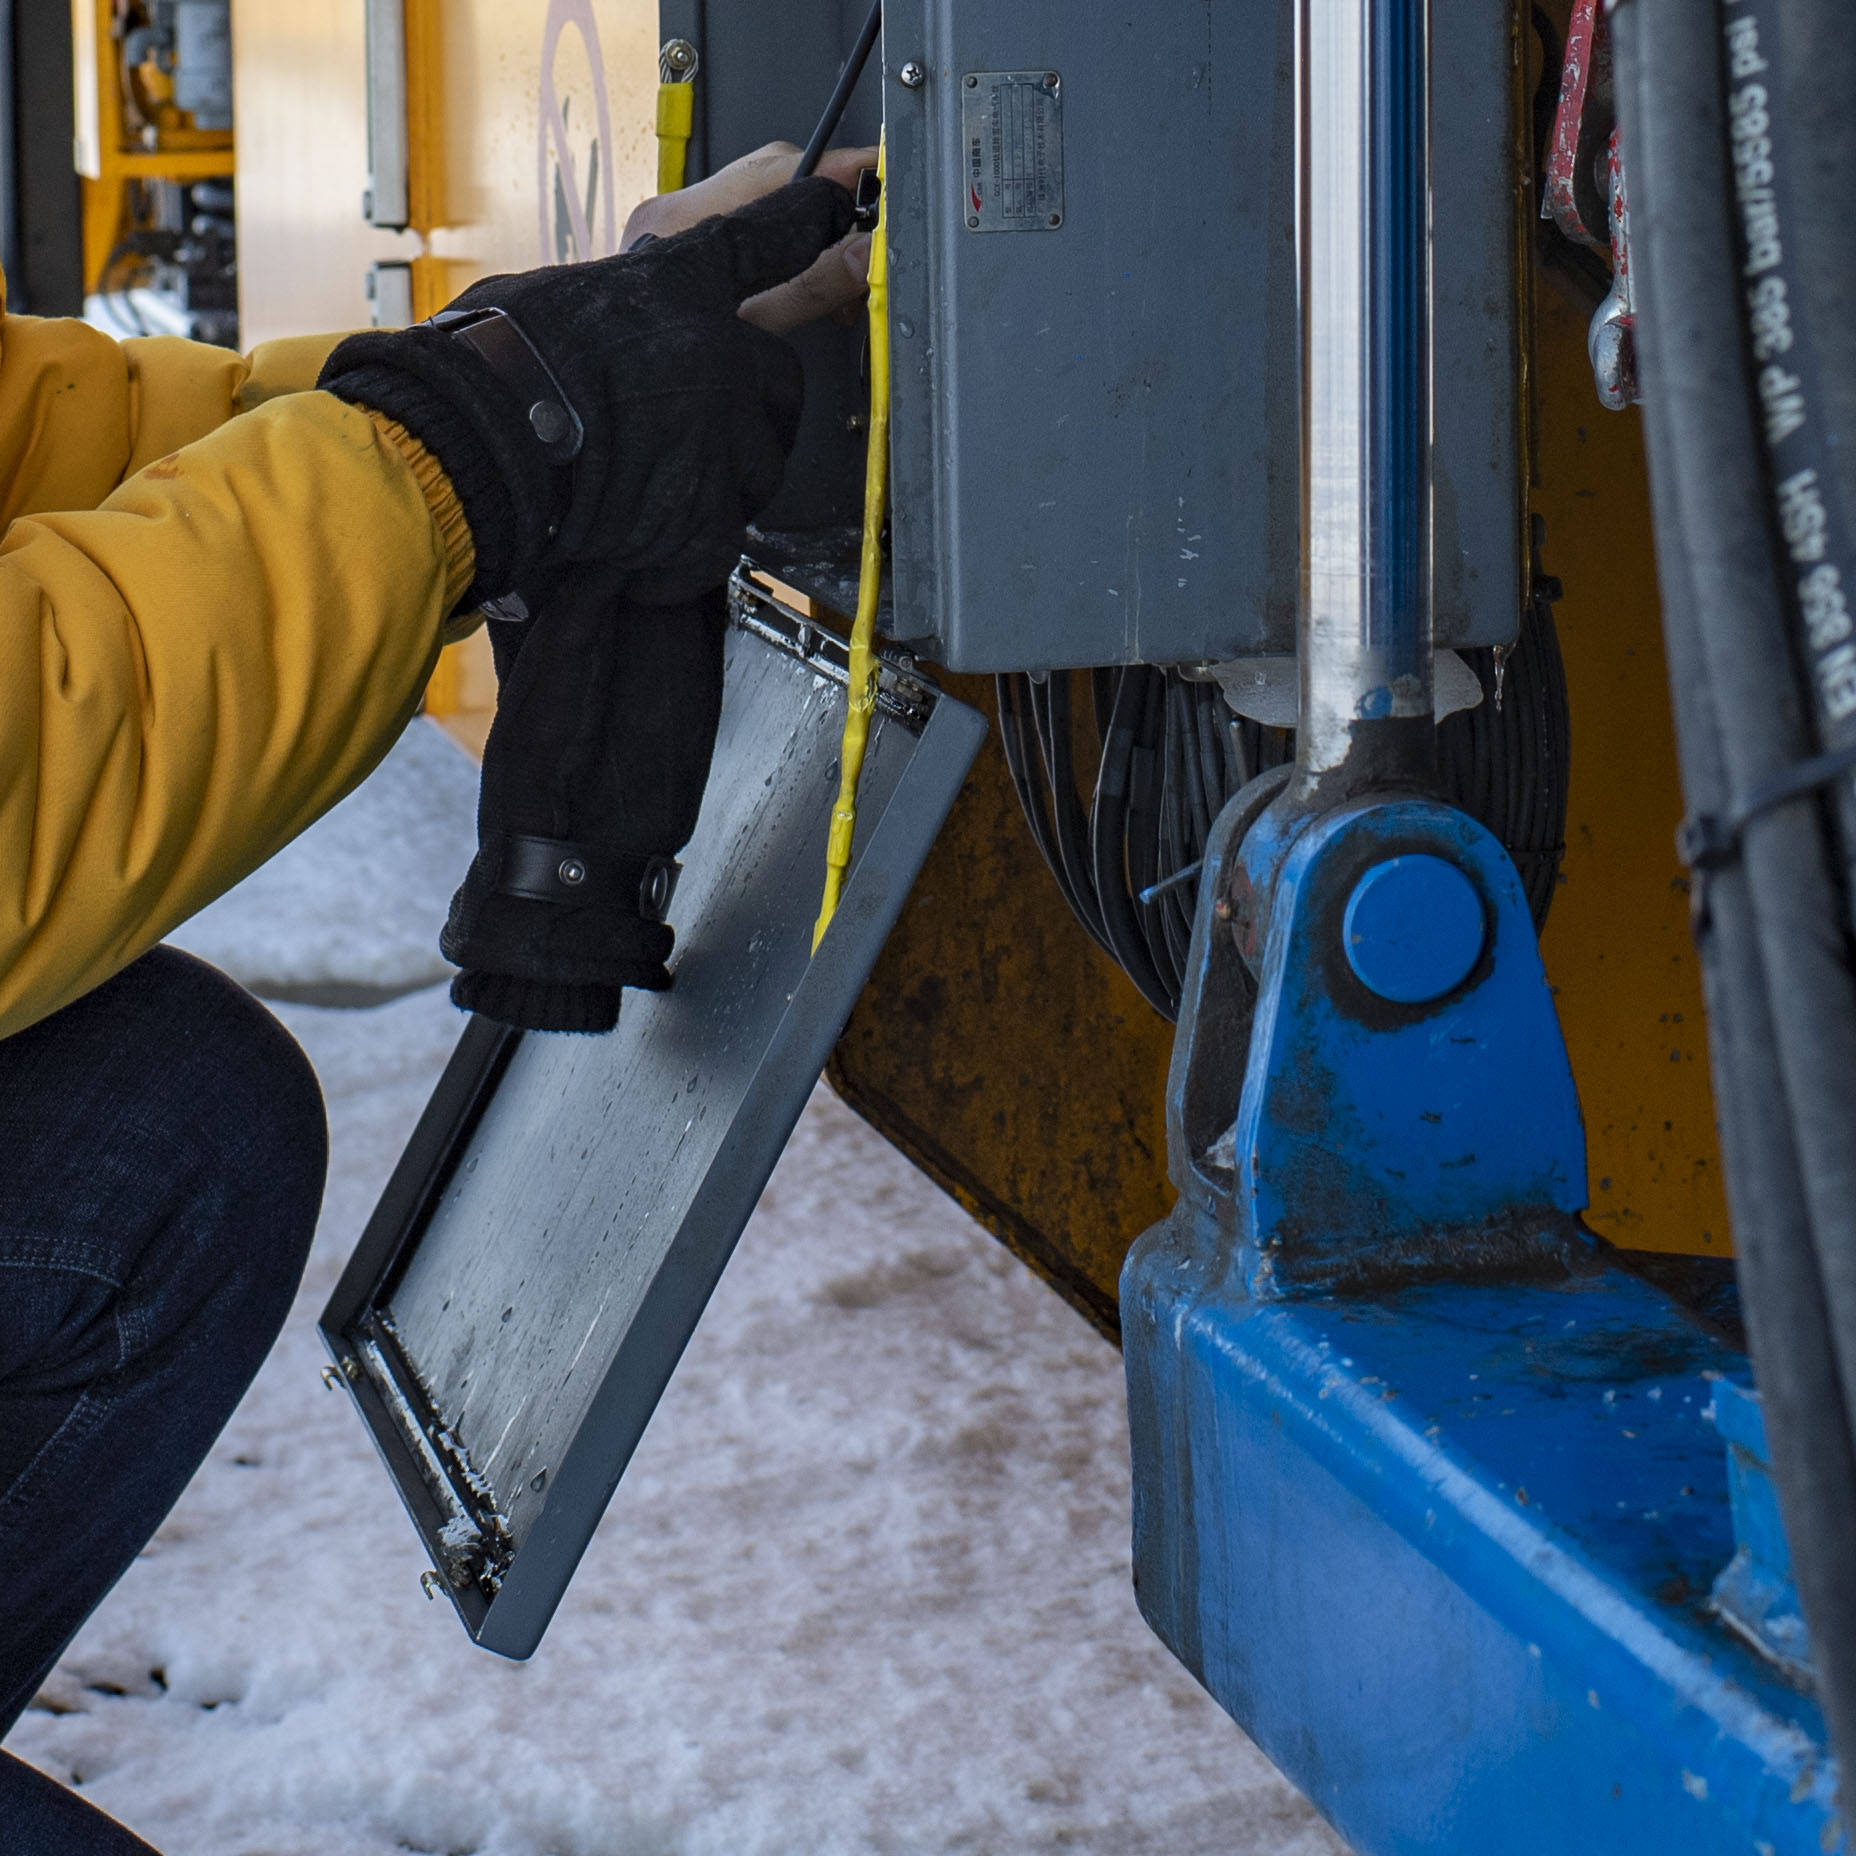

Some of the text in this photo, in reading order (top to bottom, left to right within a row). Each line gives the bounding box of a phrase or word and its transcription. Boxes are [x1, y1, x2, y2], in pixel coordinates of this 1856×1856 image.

[1729, 15, 1769, 78] psi
[1731, 82, 1782, 272] bar/5585
[1753, 275, 1794, 357] 385
[1781, 469, 1826, 562] 4SH
[1801, 563, 1853, 650] 856
